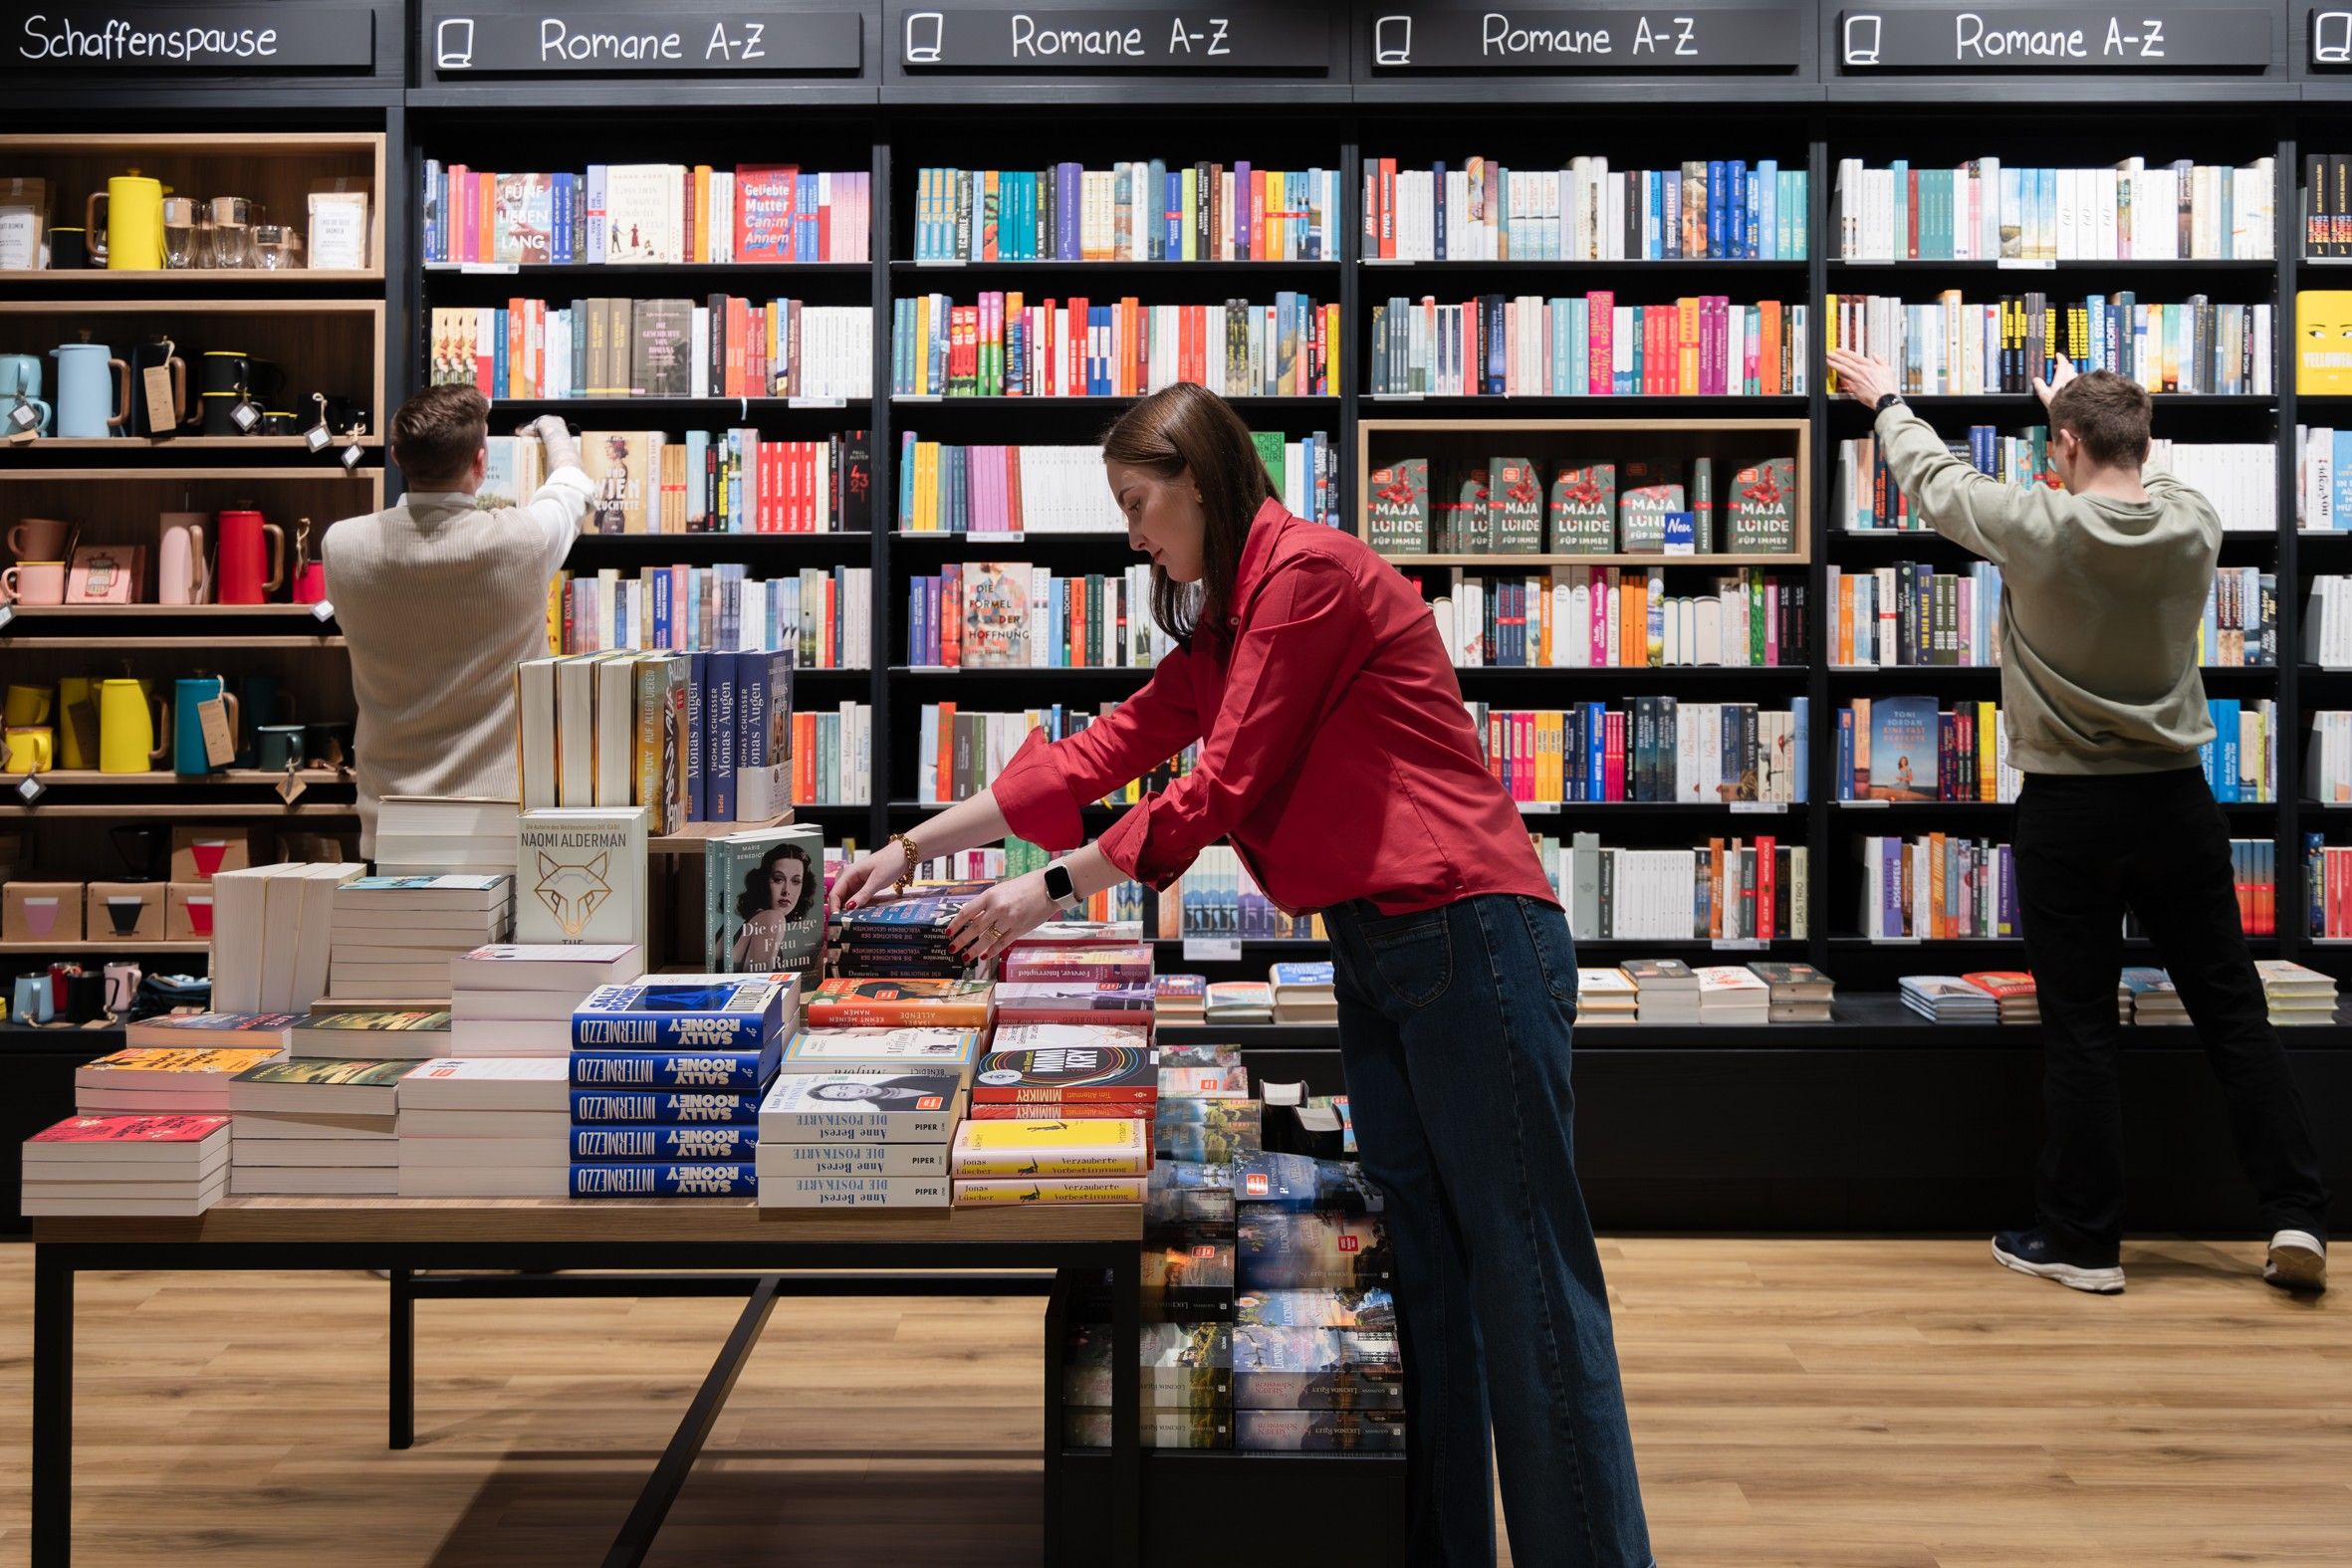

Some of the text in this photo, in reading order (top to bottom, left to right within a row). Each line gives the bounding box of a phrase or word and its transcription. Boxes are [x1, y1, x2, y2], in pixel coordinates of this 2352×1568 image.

[20, 14, 278, 62] Schaffenspause
[542, 18, 766, 62] Romane A-Z
[1012, 15, 1230, 58] Romane A-Z
[1483, 14, 1698, 57] Romane A-Z
[1957, 14, 2165, 60] Romane A-Z
[506, 183, 544, 199] FÜNF
[745, 184, 789, 195] Geliebte
[746, 199, 789, 211] Mutter
[501, 235, 545, 249] LANG
[745, 233, 789, 243] Annem
[1591, 295, 1600, 336] Gavelis
[1591, 348, 1600, 380] Poker
[1601, 347, 1610, 386] Vilnius
[605, 468, 625, 478] UND
[1375, 503, 1419, 516] MAJA
[1505, 503, 1537, 515] MAJA
[1562, 503, 1606, 516] MAJA
[1632, 500, 1675, 511] MAJA
[1741, 502, 1784, 515] MAJA
[1371, 520, 1423, 533] LUNDE
[1502, 520, 1539, 532] LUNDE
[1558, 520, 1610, 533] LUNDE
[1667, 520, 1692, 533] Neu
[1737, 519, 1788, 533] LUNDE
[1373, 537, 1390, 546] FÜR
[1503, 536, 1517, 545] FÜR
[1560, 537, 1576, 546] FÜR
[1738, 536, 1755, 545] FÜR
[976, 584, 994, 593] DIE
[644, 669, 655, 743] AUF ALLEN VIEREN
[689, 682, 701, 779] Monas Augen
[719, 681, 733, 778] Monas Augen
[522, 833, 625, 847] NAOMI ALDERMAN
[743, 918, 818, 938] Die einzige
[764, 939, 797, 953] Frau
[750, 954, 811, 972] im Raum
[589, 987, 615, 1008] SALLY
[581, 1019, 657, 1043] INTERMEZZO
[668, 1018, 741, 1032] ROONEY
[678, 1032, 733, 1044] SALLY
[665, 1058, 737, 1072] ROONEY
[1064, 1049, 1098, 1068] KRY
[578, 1058, 653, 1082] INTERMEZZO
[674, 1072, 730, 1084] SALLY
[667, 1094, 739, 1108] ROONEY
[1016, 1088, 1062, 1101] MIMIKRY
[579, 1096, 656, 1120] INTERMEZZO
[677, 1108, 732, 1120] SALLY
[1016, 1106, 1061, 1119] MIMIKRY
[797, 1115, 887, 1125] DIE POSTKARTE
[666, 1130, 739, 1144] ROONEY
[820, 1129, 887, 1139] Anne Berest
[578, 1131, 655, 1155] INTERMEZZO
[677, 1144, 732, 1156] SALLY
[794, 1149, 884, 1159] DIE POSTKARTE
[666, 1166, 739, 1180] ROONEY
[818, 1163, 884, 1173] Anne Berest
[578, 1169, 654, 1192] INTERMEZZO
[676, 1180, 732, 1193] SALLY
[797, 1180, 887, 1190] DIE POSTKARTE
[820, 1195, 887, 1204] Anne Berest
